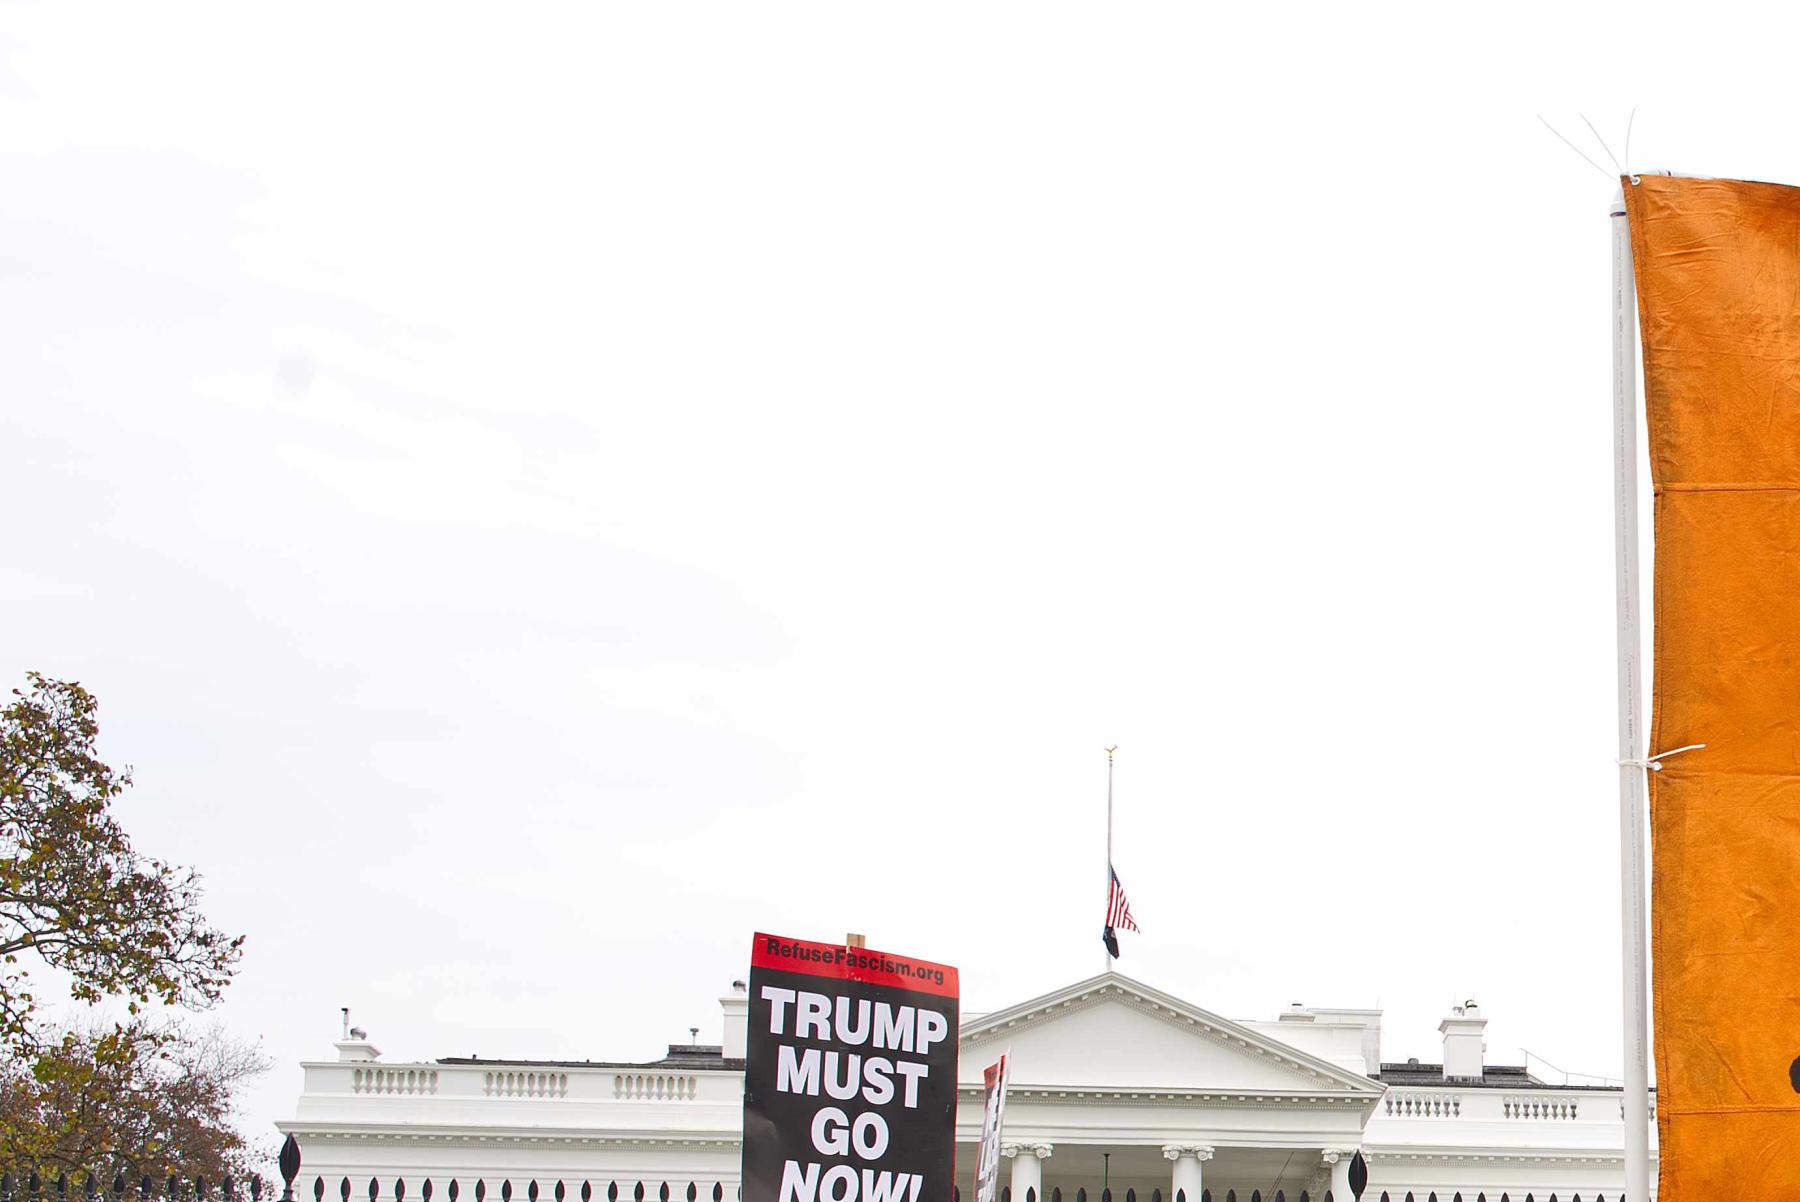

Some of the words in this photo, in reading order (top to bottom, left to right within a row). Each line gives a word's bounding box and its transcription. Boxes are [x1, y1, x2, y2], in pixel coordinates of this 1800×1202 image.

[766, 938, 944, 986] RefuseFascism.org
[761, 985, 948, 1055] TRUMP
[776, 1045, 928, 1109] MUST
[811, 1106, 889, 1160] GO
